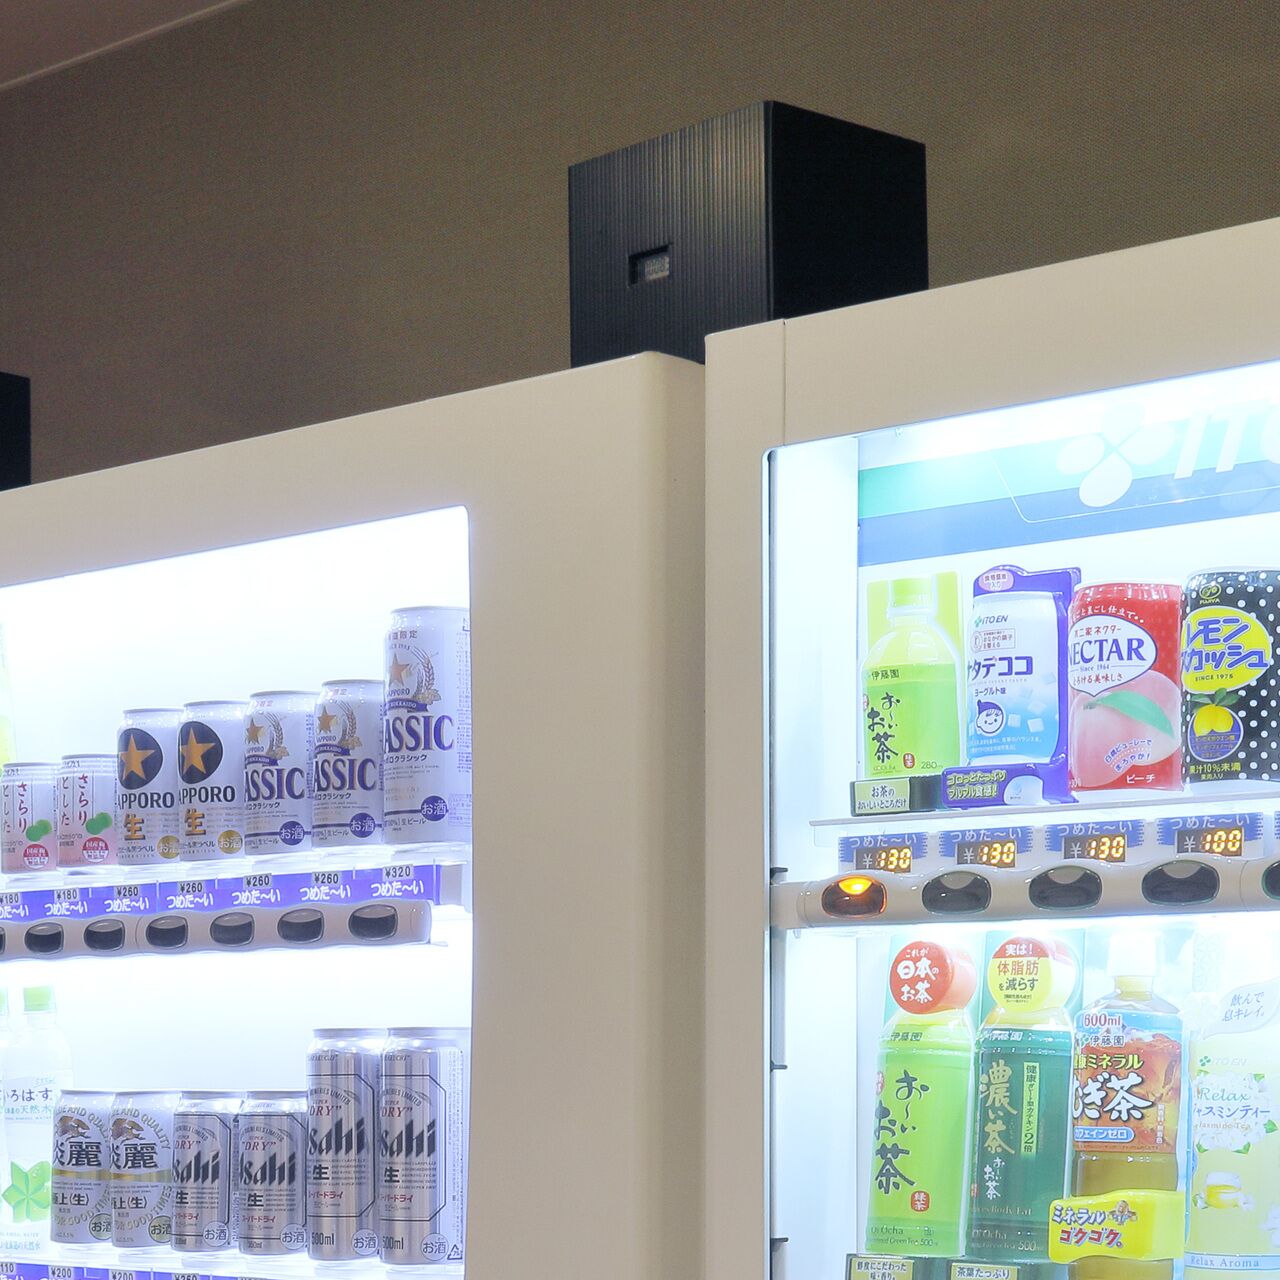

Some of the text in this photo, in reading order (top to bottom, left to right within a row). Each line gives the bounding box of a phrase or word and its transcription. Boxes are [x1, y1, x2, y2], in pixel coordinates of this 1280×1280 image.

[1186, 617, 1251, 647] レモン
[974, 687, 1006, 697] ヨーグルト味
[1127, 775, 1155, 784] ピーチ
[871, 786, 894, 798] お茶の
[857, 799, 906, 810] おいしいところだけ
[350, 818, 374, 833] お酒
[905, 948, 929, 958] これが
[896, 958, 939, 980] 日本の
[997, 961, 1039, 976] 体脂肪
[998, 978, 1039, 991] を減らす
[901, 982, 933, 1003] お茶
[1083, 1013, 1121, 1028] 600ml
[1090, 1035, 1125, 1047] 伊藤園
[1200, 1087, 1249, 1102] Relax
[1052, 1204, 1106, 1226] ミネラル
[353, 1236, 377, 1249] お酒
[1190, 1257, 1260, 1268] Relax Aroma
[956, 1266, 1010, 1280] 茶葉たっぷり
